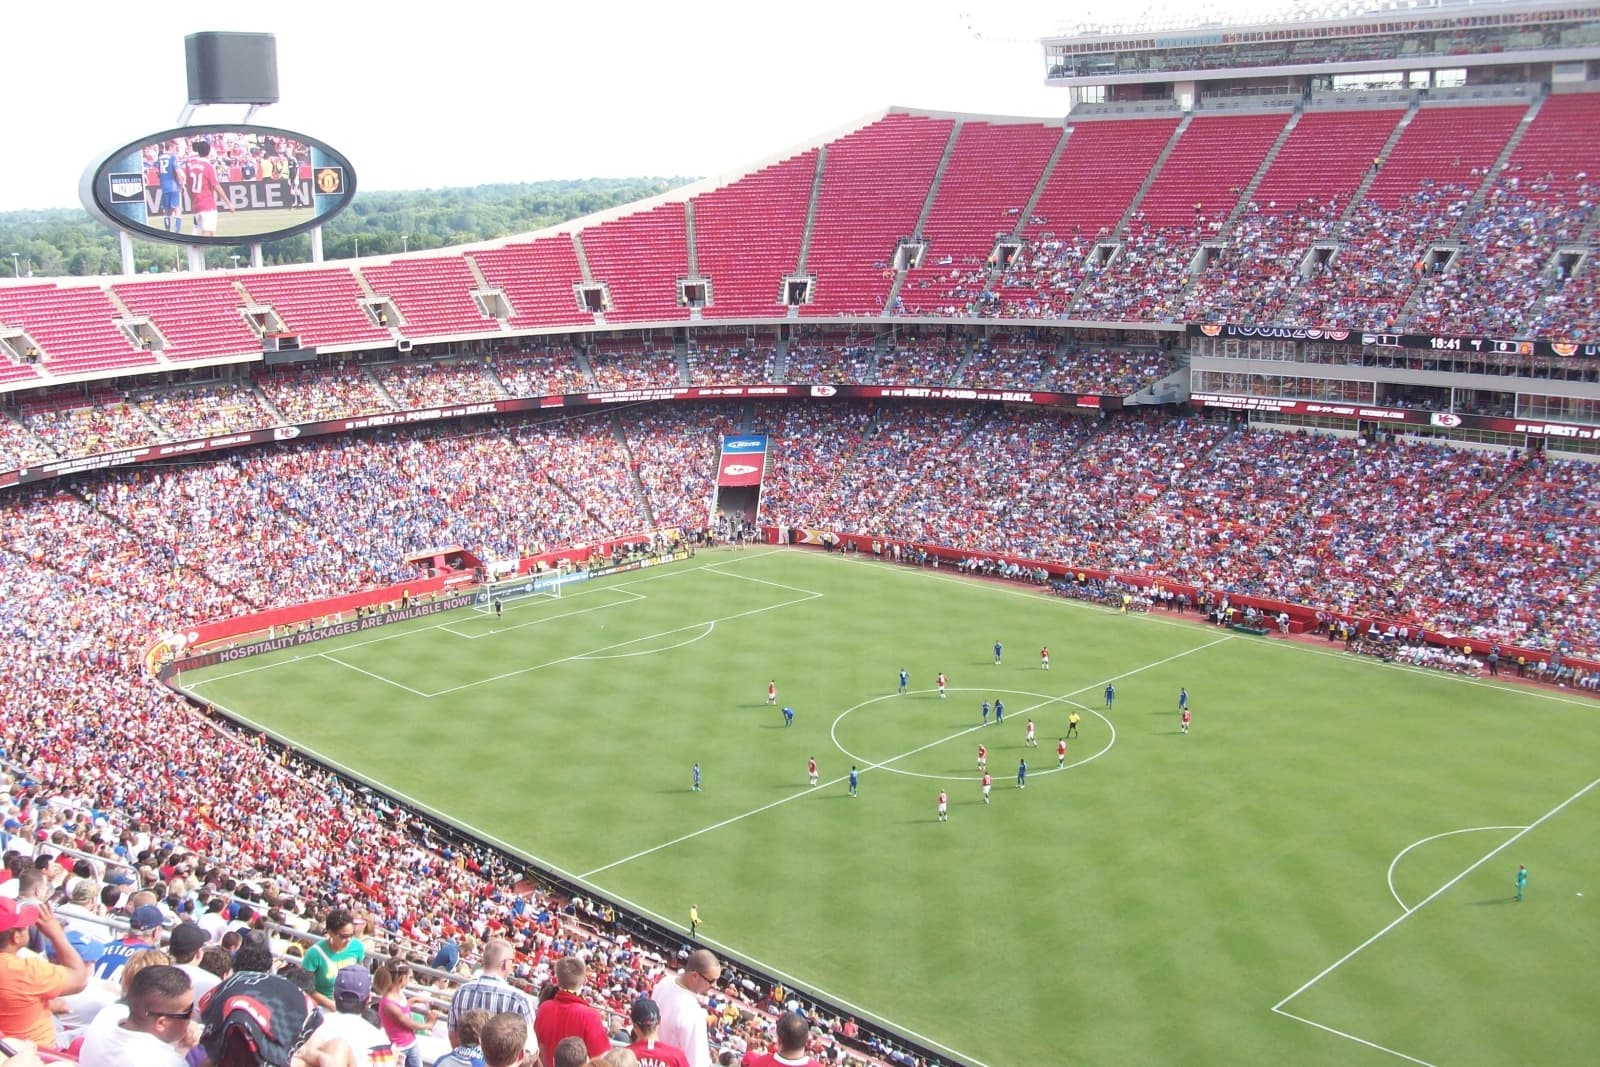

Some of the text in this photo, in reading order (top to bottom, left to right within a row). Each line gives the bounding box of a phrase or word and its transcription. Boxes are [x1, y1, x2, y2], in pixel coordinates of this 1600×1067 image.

[1430, 337, 1461, 350] 18:41
[220, 637, 296, 662] HOSPITALITY
[298, 619, 358, 644] PACKAGES
[360, 615, 384, 630] ARE
[384, 602, 442, 625] AVAILABLE
[443, 595, 472, 611] NOW!
